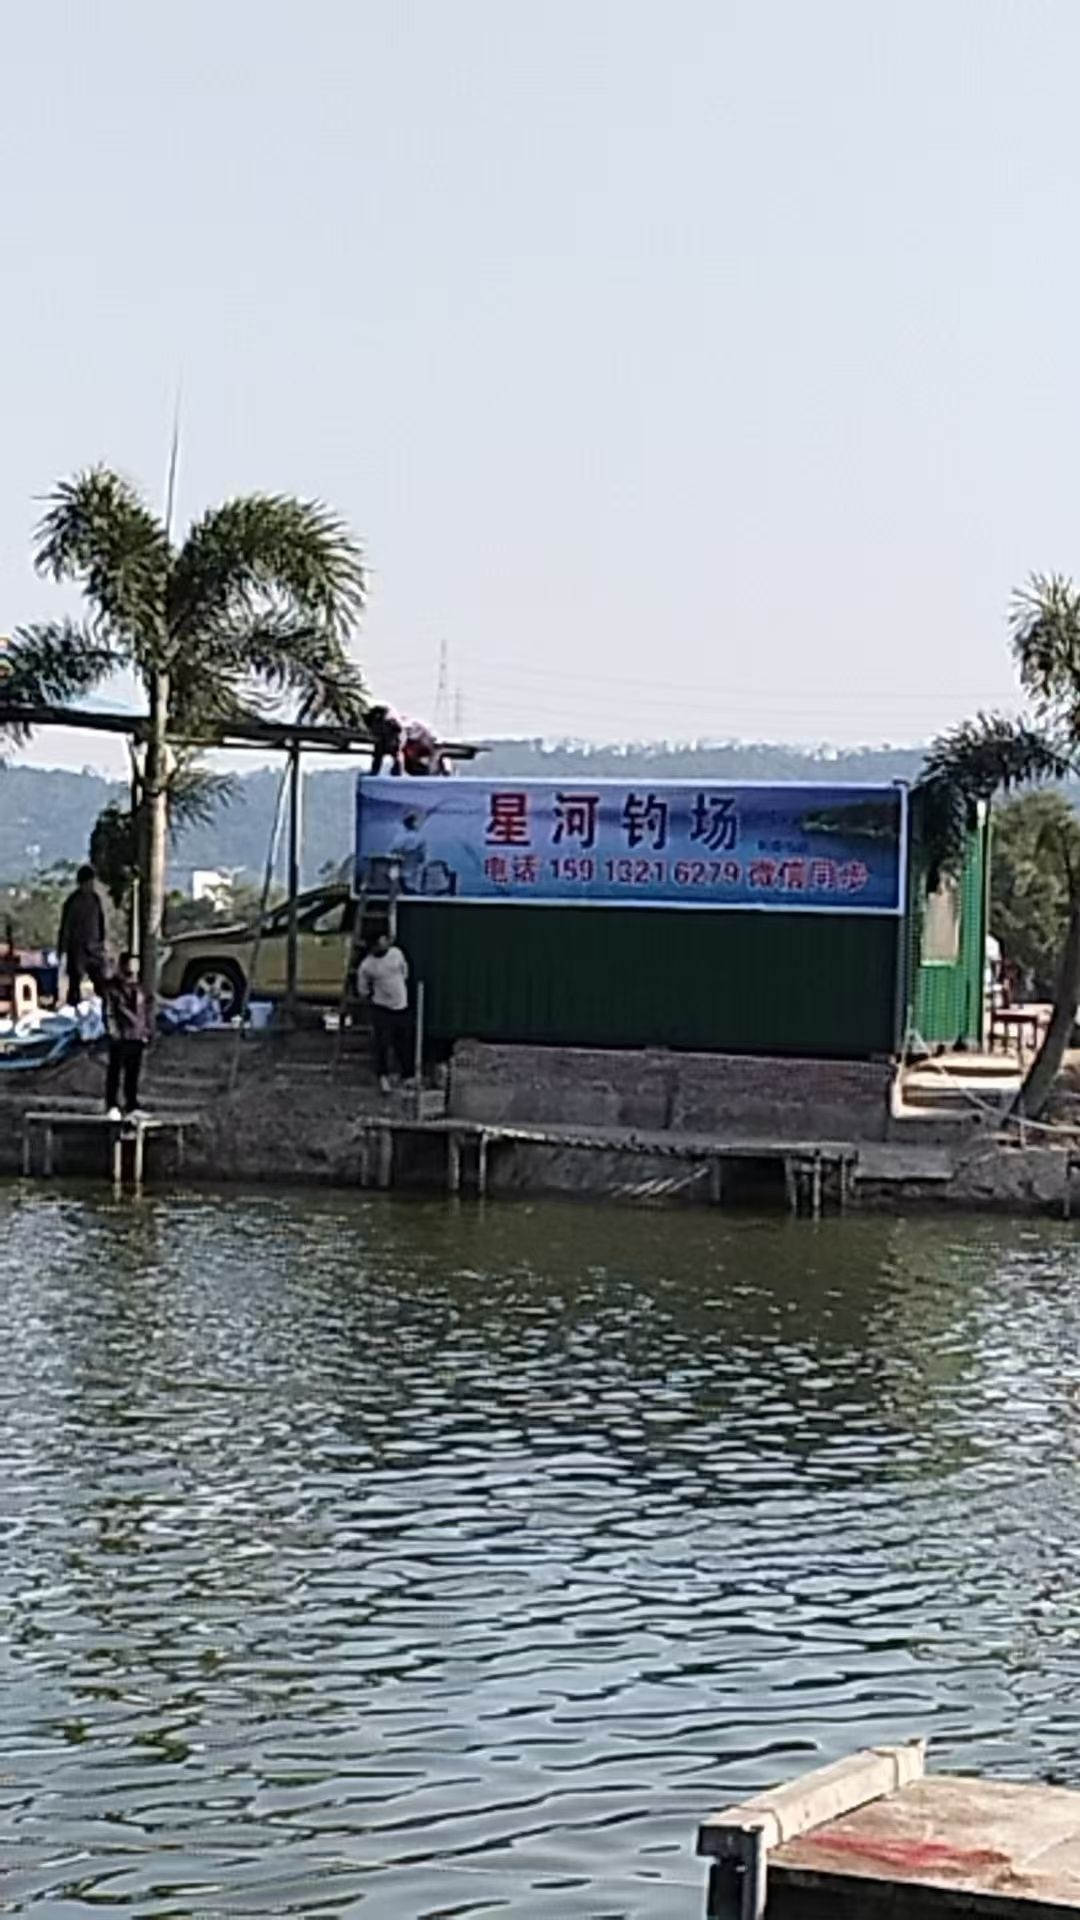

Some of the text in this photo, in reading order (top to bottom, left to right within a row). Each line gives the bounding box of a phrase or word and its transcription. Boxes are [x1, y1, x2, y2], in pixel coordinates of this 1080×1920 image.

[484, 791, 738, 851] 星河钓场
[484, 855, 537, 884] 电话
[550, 857, 594, 882] 159
[605, 858, 665, 883] 1321
[674, 860, 740, 886] 6279
